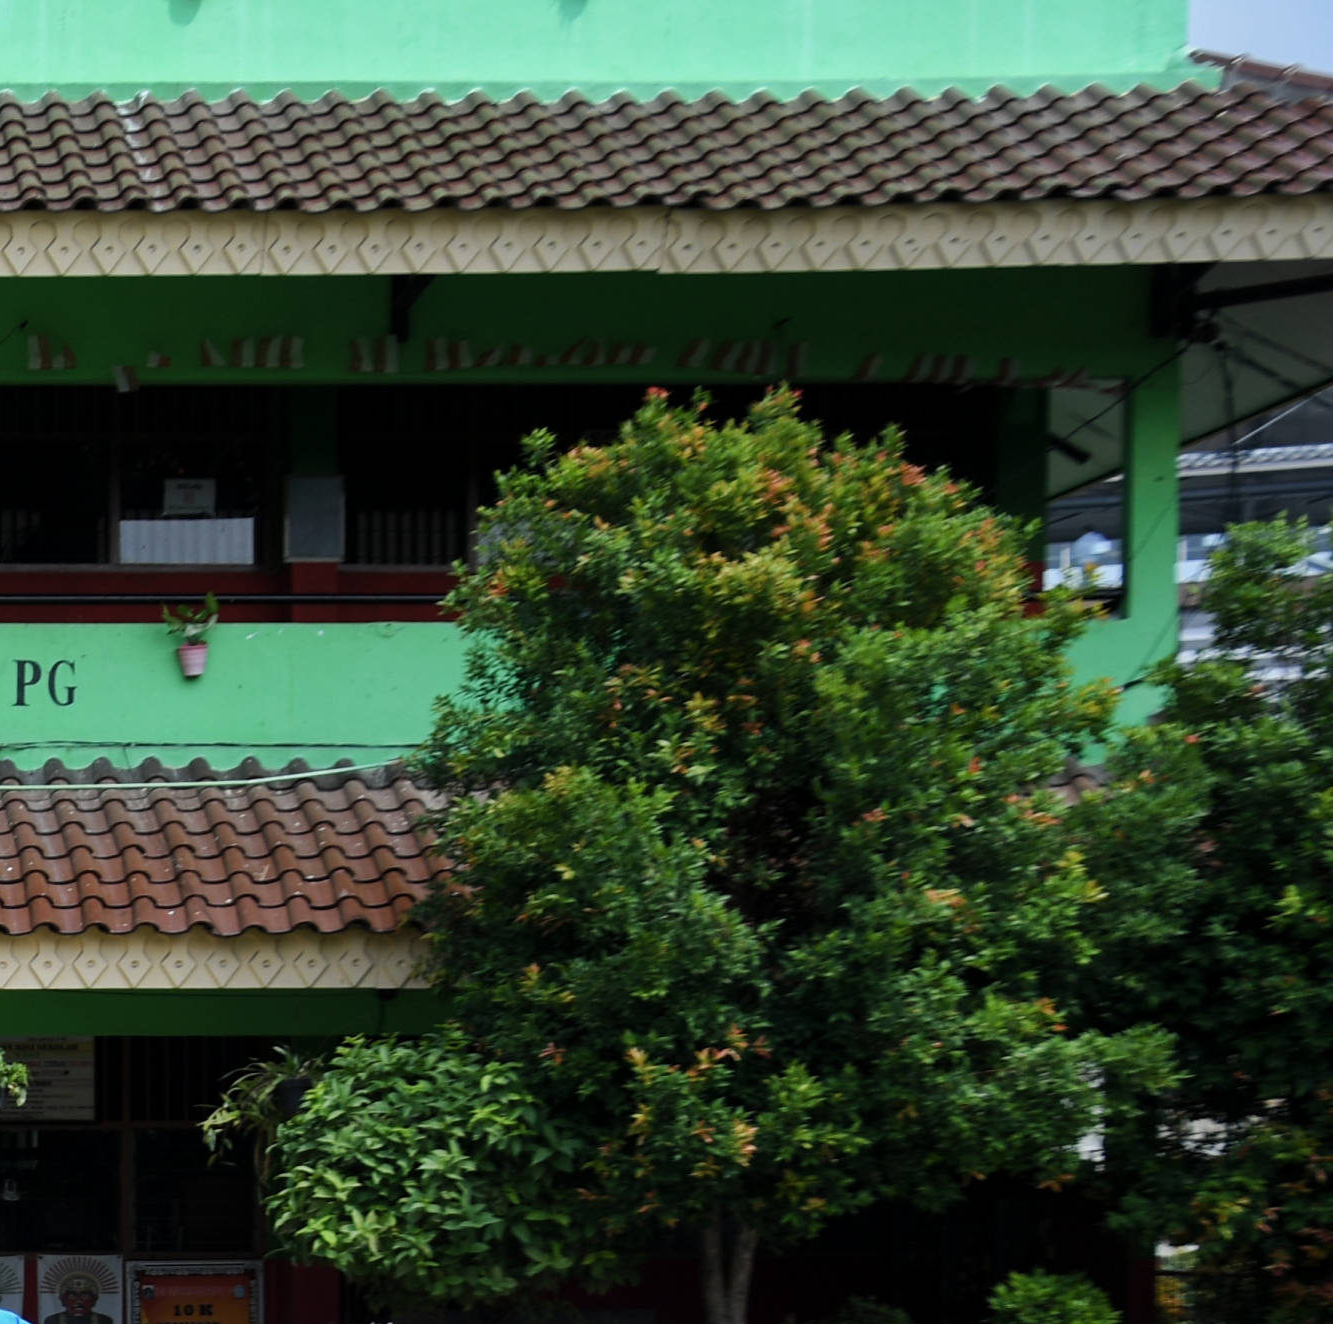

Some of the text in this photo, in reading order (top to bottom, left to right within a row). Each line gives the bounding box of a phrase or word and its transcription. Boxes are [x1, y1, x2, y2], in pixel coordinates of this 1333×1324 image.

[12, 658, 79, 707] PG
[173, 1304, 213, 1316] 10 K
